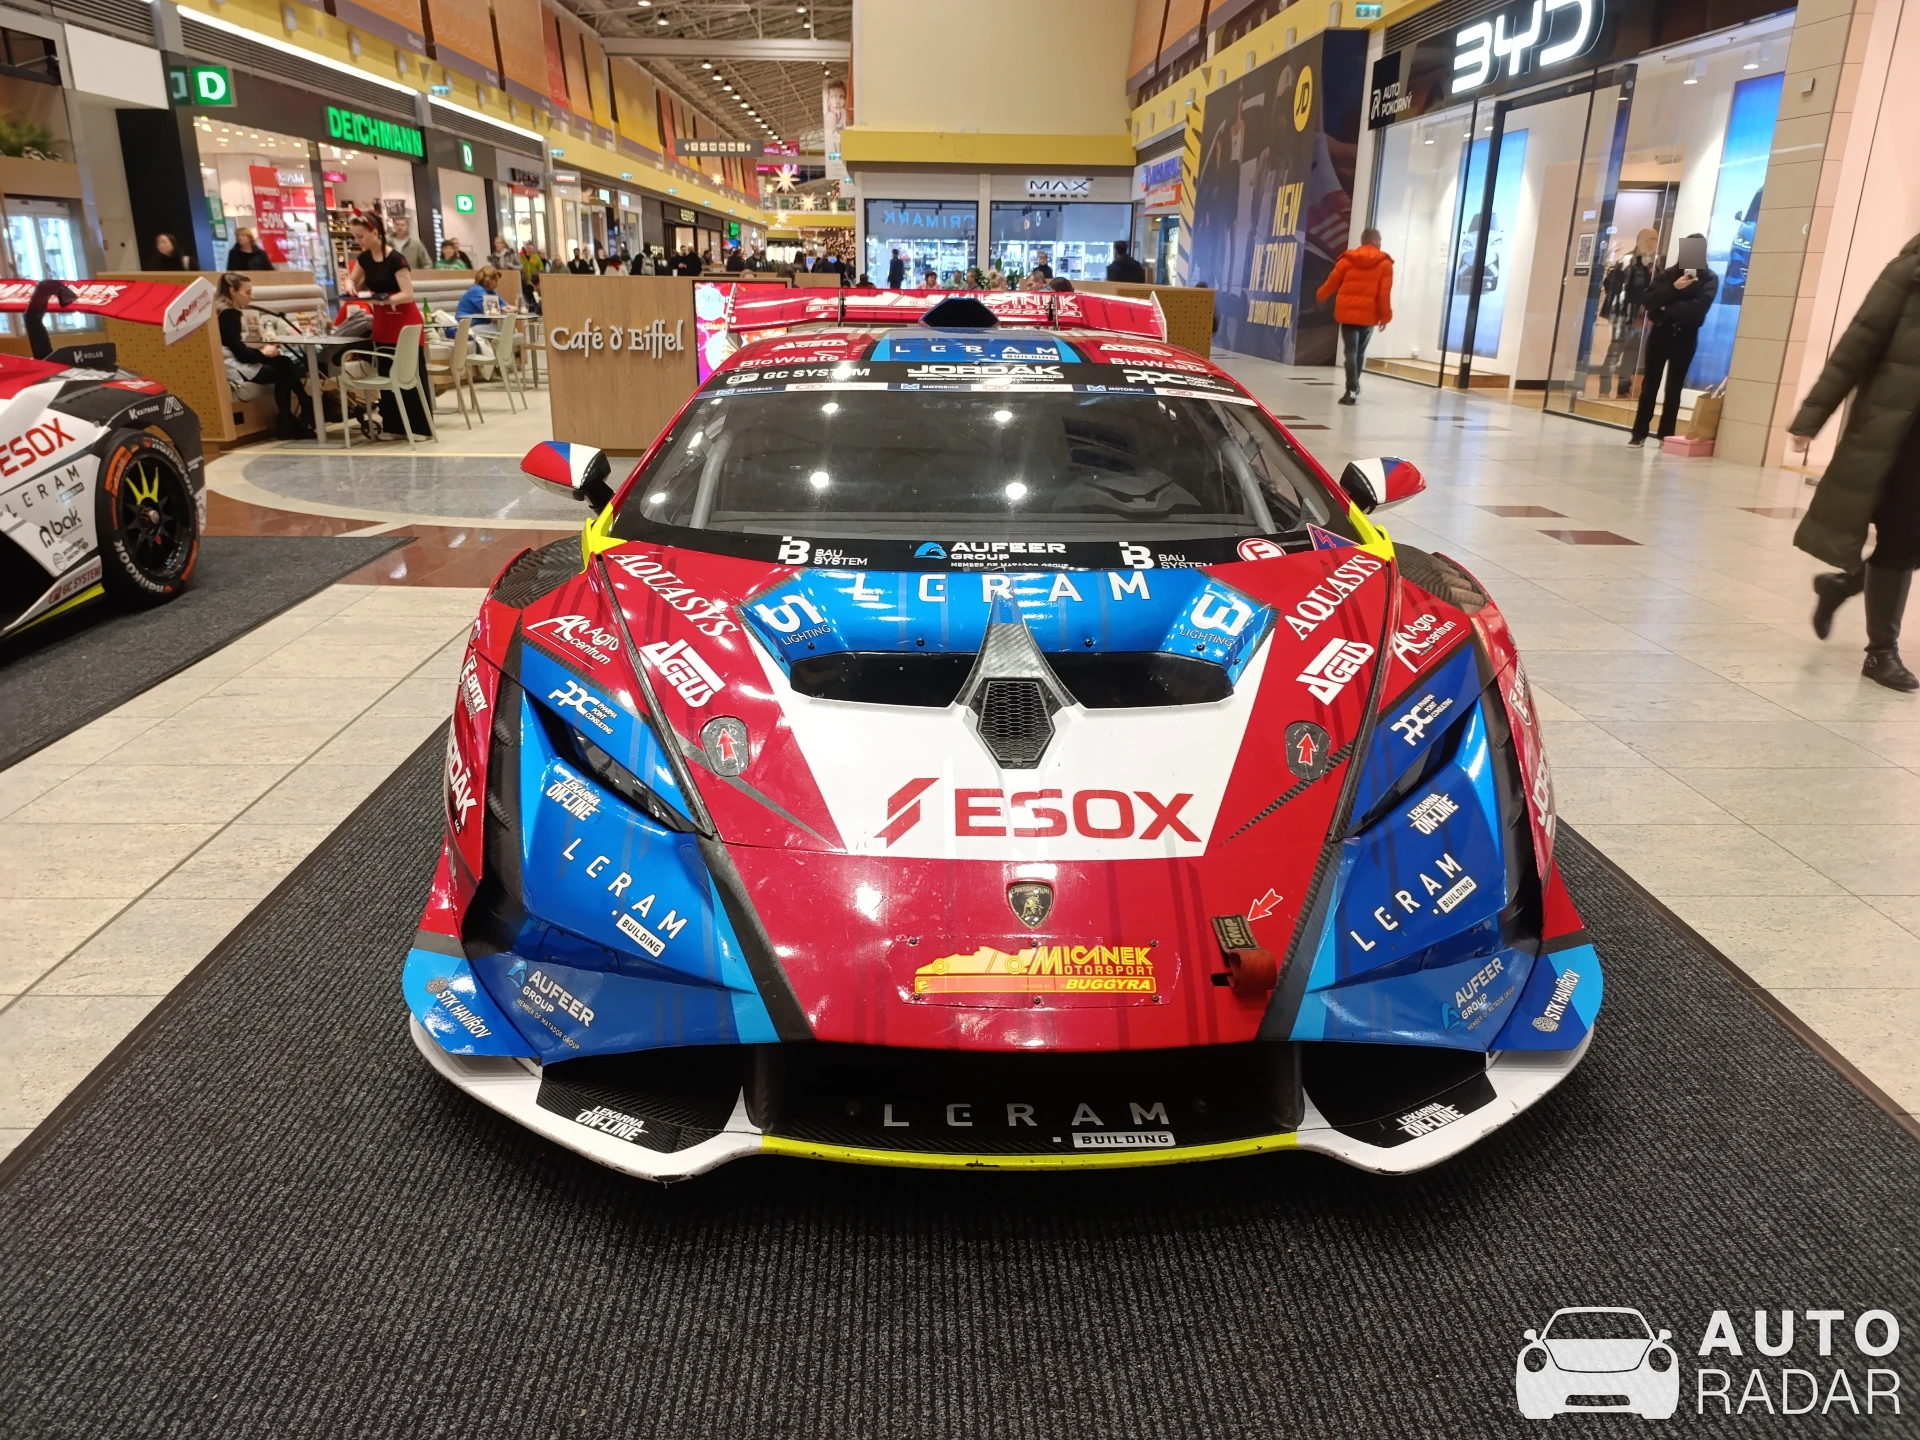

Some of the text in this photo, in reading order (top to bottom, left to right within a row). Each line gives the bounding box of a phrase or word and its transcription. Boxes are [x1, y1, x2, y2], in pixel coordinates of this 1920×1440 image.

[198, 71, 226, 100] D
[1383, 82, 1400, 100] AUTO
[1381, 91, 1412, 117] POKORNÝ
[327, 105, 423, 157] DEICHMANN
[1030, 180, 1088, 190] MAX
[457, 195, 473, 211] D
[1272, 182, 1304, 237] NEW
[1249, 242, 1298, 293] IN TOWN
[550, 318, 603, 358] Café
[895, 345, 1058, 355] LERAM
[740, 355, 840, 368] BioWaste
[763, 371, 790, 380] GC
[793, 368, 871, 379] SYSM
[1110, 357, 1208, 373] BioWaste
[1122, 369, 1188, 385] PPC
[0, 417, 76, 477] ESOX
[815, 548, 843, 557] BAU
[951, 542, 1067, 553] AUFEER
[813, 557, 868, 566] SYSTEM
[73, 566, 101, 588] SYSTEM
[853, 573, 1150, 603] LERAM
[608, 553, 739, 638] AQUASYS
[1284, 554, 1382, 640] AQUASYS
[781, 624, 831, 645] LIGHTING
[1180, 627, 1236, 647] LIGHTING
[1404, 614, 1436, 636] Agro
[1426, 621, 1457, 643] centrum
[570, 638, 611, 665] centrum
[467, 672, 488, 713] ENTRY
[584, 711, 614, 735] CONSULTING
[591, 707, 608, 720] POINT
[597, 702, 618, 718] PHARMA
[546, 782, 597, 821] ON-LINE
[563, 778, 600, 805] LEKARNA
[955, 788, 1202, 843] ESOX
[1407, 793, 1441, 820] LEKARNA
[1415, 796, 1459, 834] ON-LINE
[563, 837, 688, 940] LERAM
[1442, 879, 1473, 909] BUILDING
[1350, 853, 1463, 952] LERAM
[622, 918, 662, 954] BUILDING
[1224, 918, 1246, 945] OMP
[1065, 978, 1151, 990] BUGGYRA
[1455, 957, 1505, 1008] AUFEER
[522, 985, 555, 1013] GROUP
[528, 970, 595, 1027] AUFEER
[1461, 993, 1487, 1020] GROUP
[1467, 1016, 1483, 1031] MEMBER
[1488, 996, 1504, 1012] MATADOR
[1503, 985, 1515, 998] GROUP
[1544, 1000, 1565, 1020] STK
[436, 990, 492, 1038] STK HAVÍŘOV
[517, 998, 580, 1050] MEMBER OF MATADOR GROUP
[576, 1109, 643, 1142] ON-LINE
[592, 1105, 645, 1128] LEKARNA
[884, 1102, 1170, 1127] LERAM
[1396, 1102, 1445, 1128] LEKARNA
[1405, 1104, 1466, 1137] ON-LINE
[1081, 1134, 1169, 1145] BUILDING
